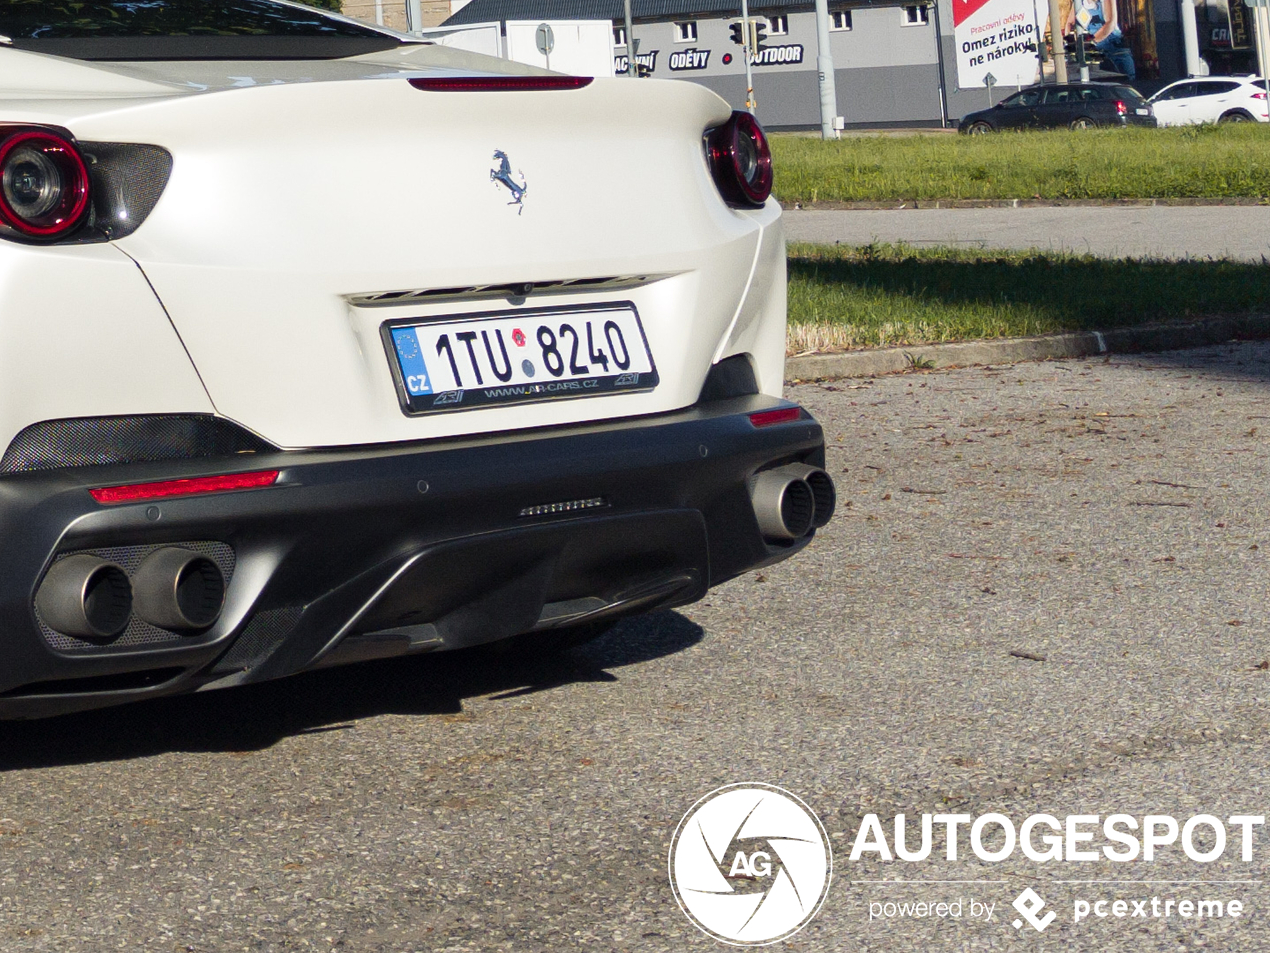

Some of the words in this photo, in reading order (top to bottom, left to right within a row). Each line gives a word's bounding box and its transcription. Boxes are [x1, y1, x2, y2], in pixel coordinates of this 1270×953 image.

[970, 18, 1001, 35] Pracovní
[962, 35, 997, 53] Omez
[998, 23, 1033, 42] riziko
[670, 48, 709, 68] ODĚVY
[969, 54, 984, 67] ne
[436, 329, 513, 388] 1TU
[536, 320, 631, 378] 8240
[407, 374, 429, 392] CZ
